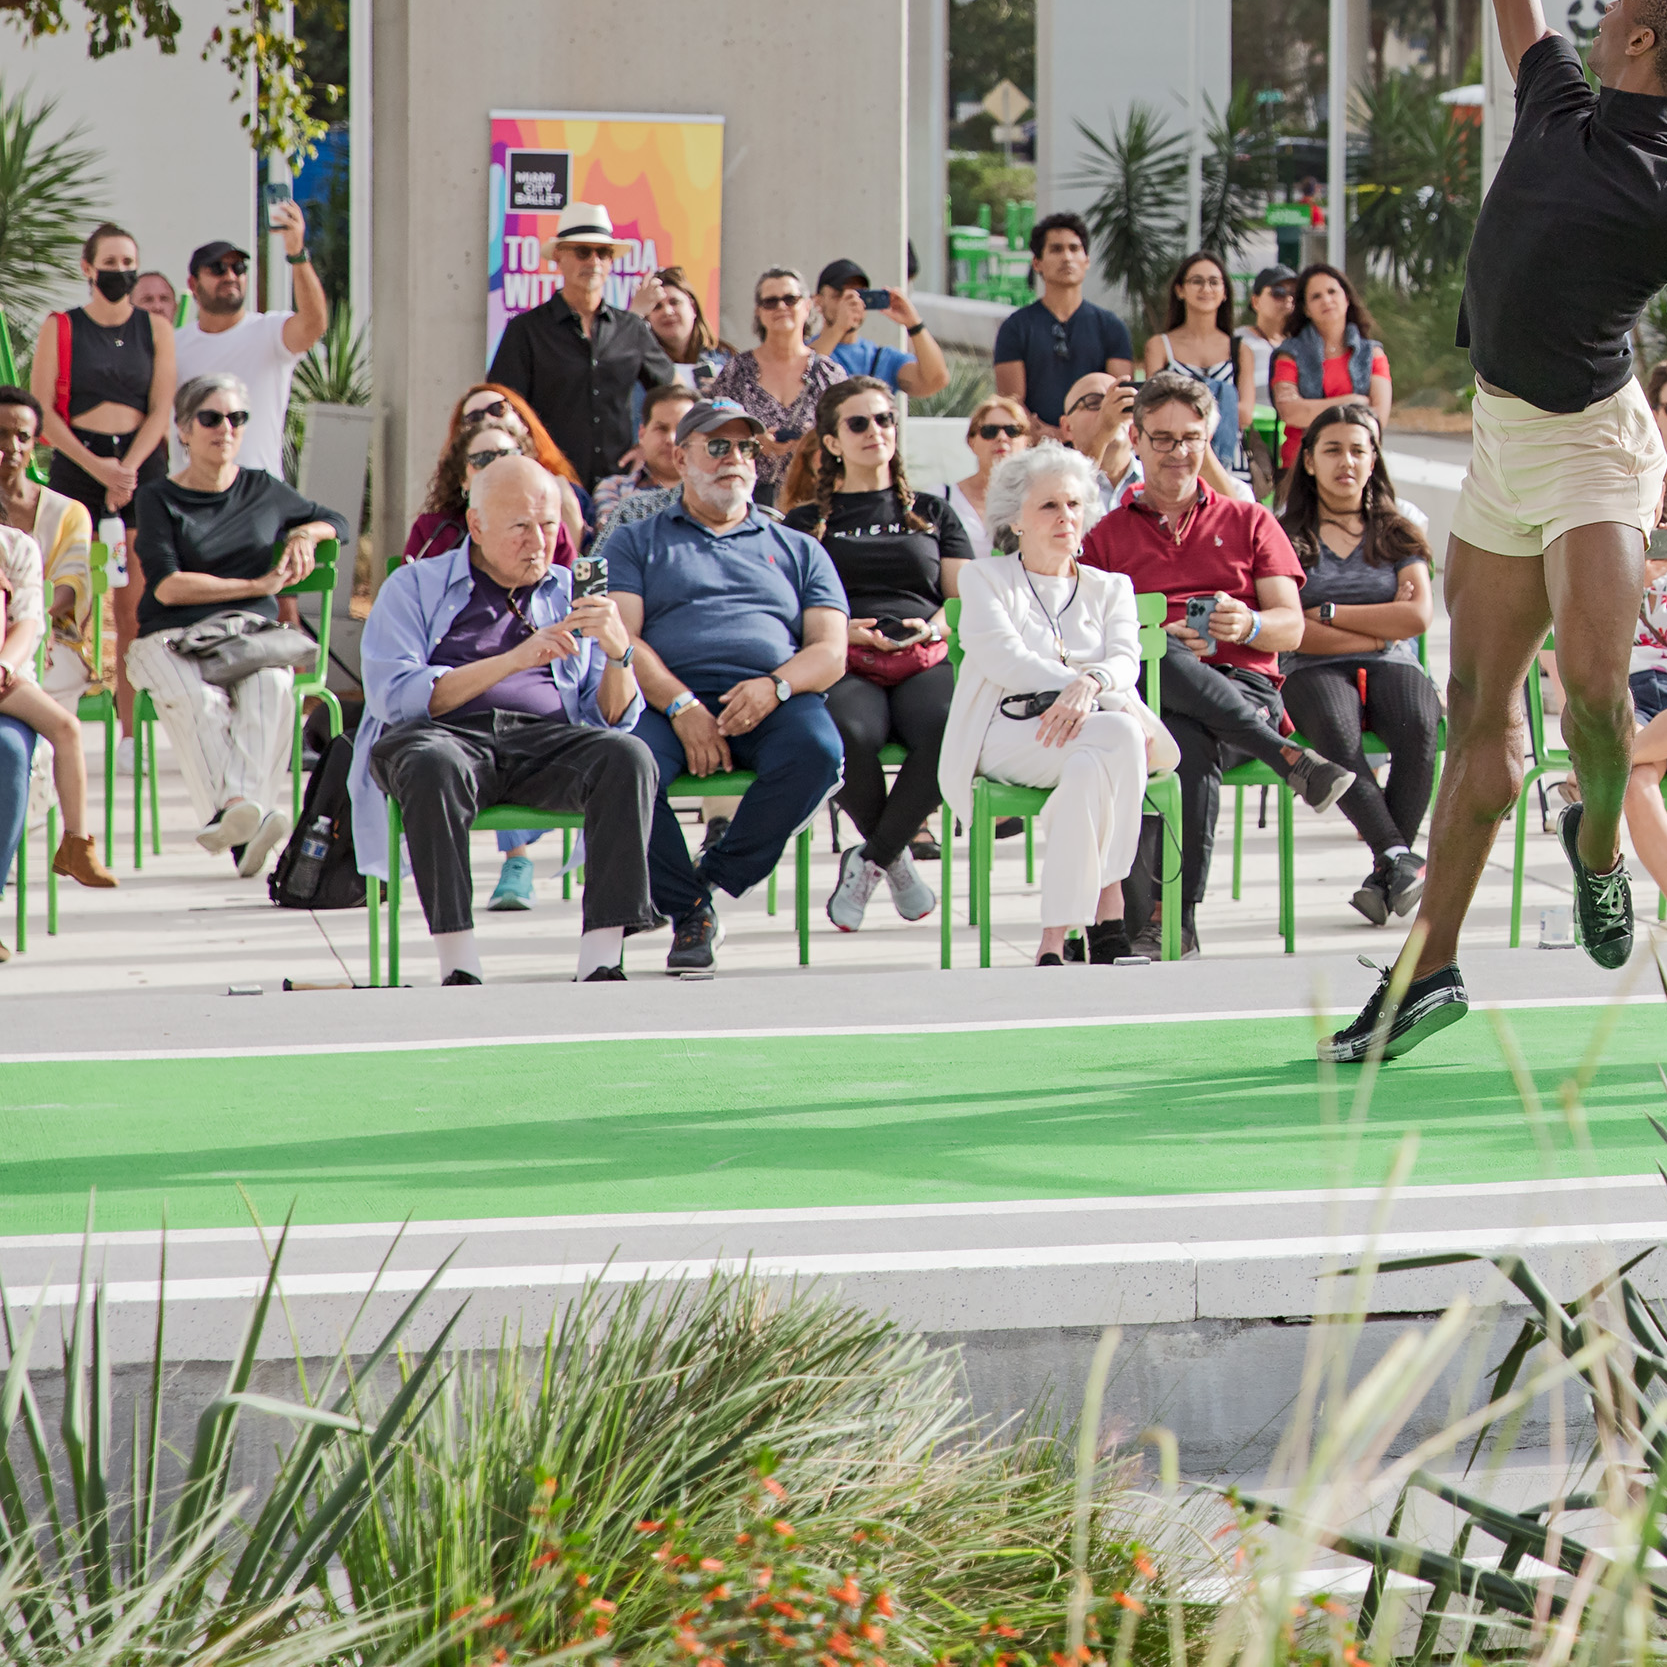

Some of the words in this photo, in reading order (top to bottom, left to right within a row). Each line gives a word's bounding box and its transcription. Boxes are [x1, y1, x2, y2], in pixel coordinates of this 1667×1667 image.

[514, 171, 556, 184] MIAMI
[523, 181, 555, 195] CITY
[514, 192, 563, 206] BALLET
[504, 235, 540, 272] TO
